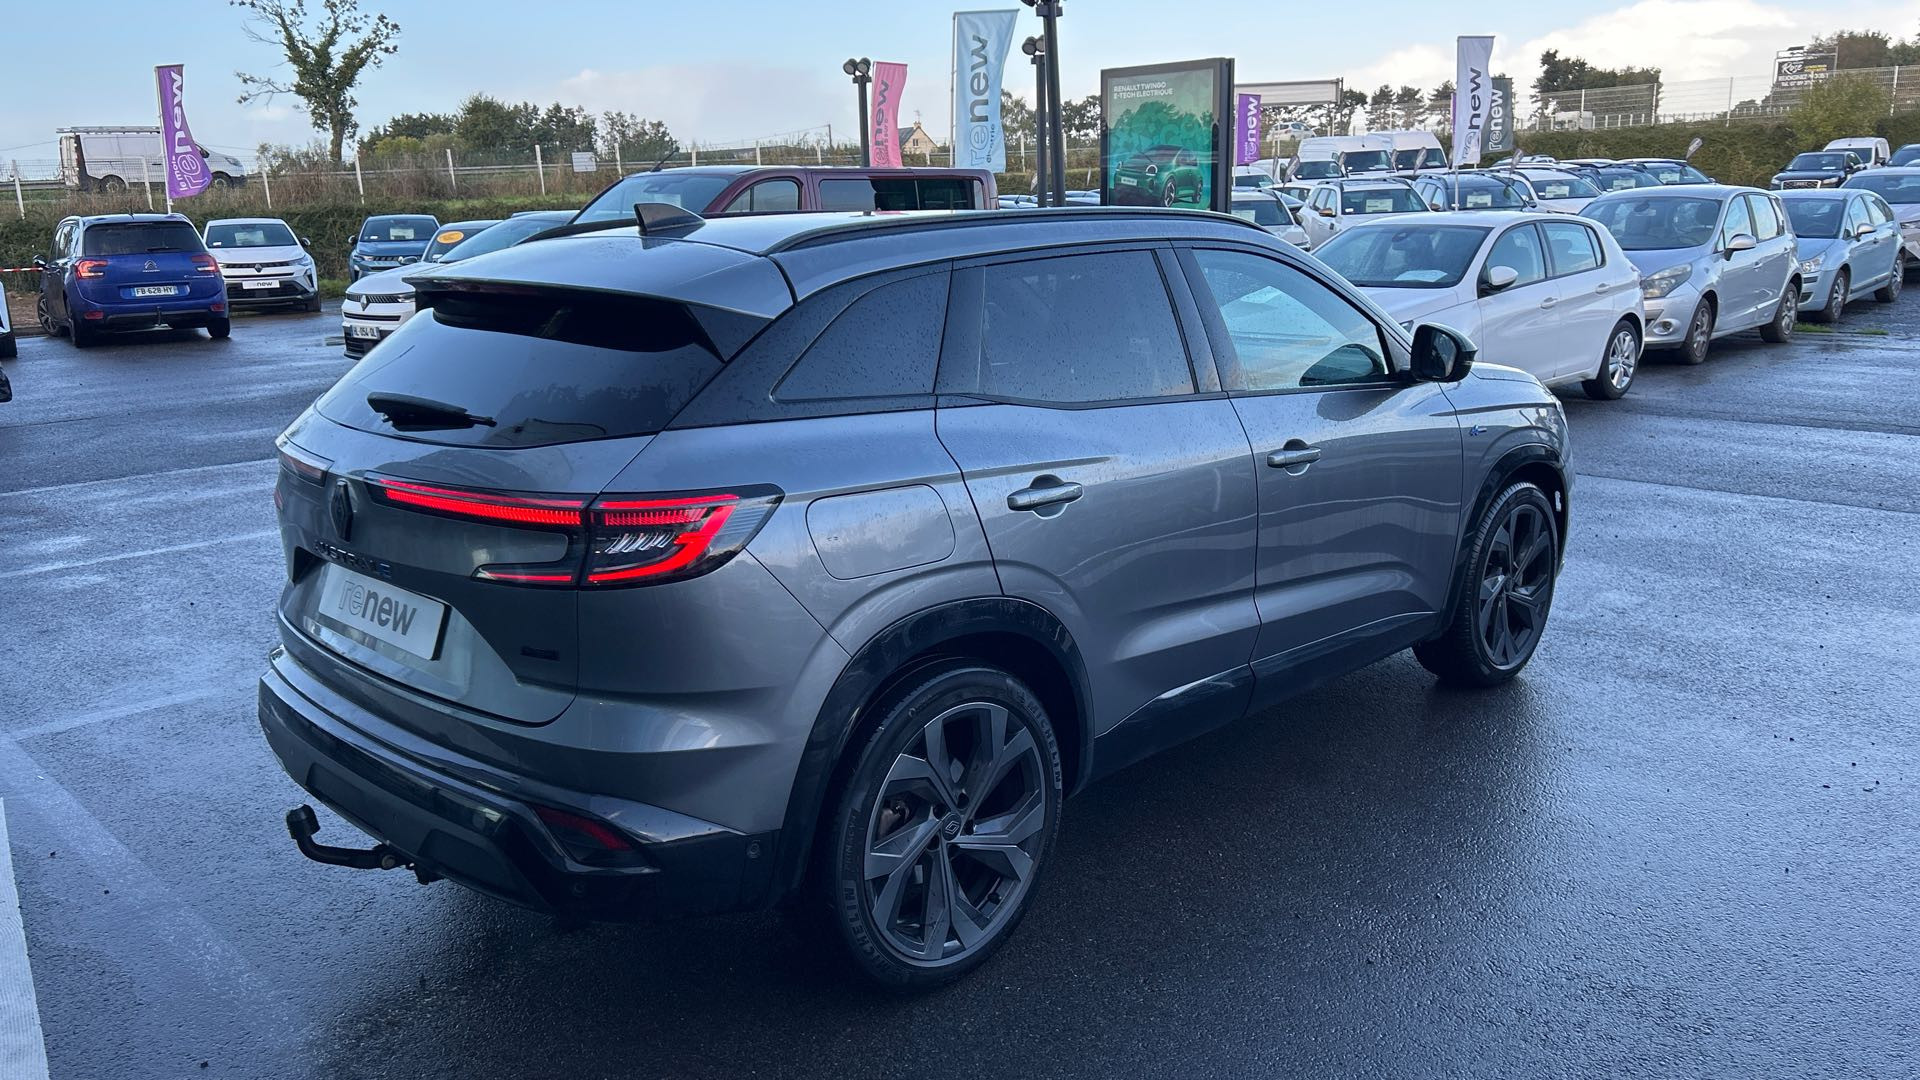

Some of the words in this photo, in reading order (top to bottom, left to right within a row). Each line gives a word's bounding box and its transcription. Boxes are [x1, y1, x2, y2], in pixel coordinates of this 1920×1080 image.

[874, 80, 890, 164] enew
[969, 35, 989, 166] renew
[1113, 83, 1141, 92] RENAULT
[1141, 82, 1166, 90] TWINGO
[1113, 91, 1136, 99] E-TECH
[1462, 67, 1482, 159] renew
[1489, 89, 1503, 151] renew
[170, 71, 208, 189] renew
[1246, 97, 1258, 161] renew
[339, 580, 418, 636] renew
[1027, 700, 1062, 783] MICHELIN
